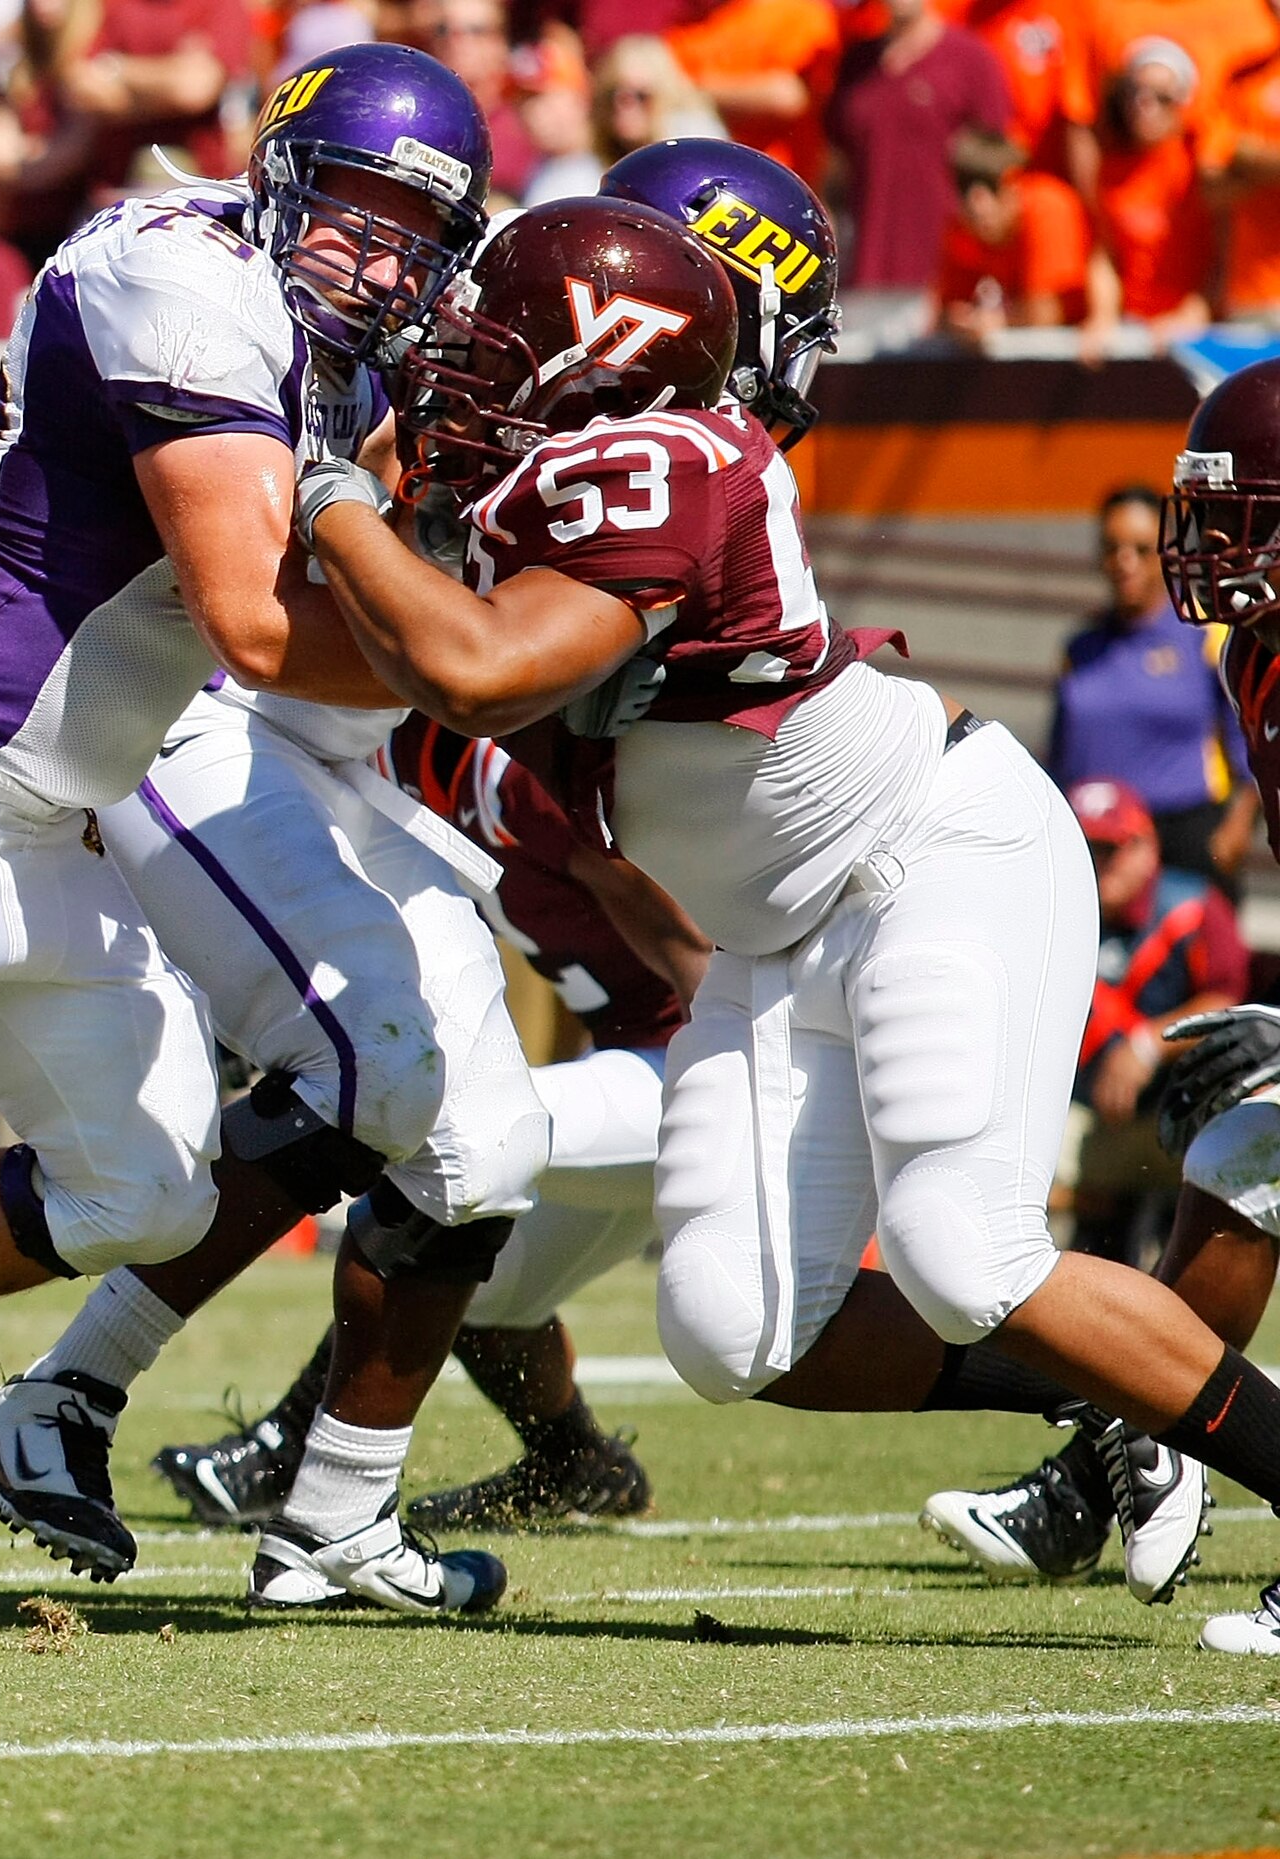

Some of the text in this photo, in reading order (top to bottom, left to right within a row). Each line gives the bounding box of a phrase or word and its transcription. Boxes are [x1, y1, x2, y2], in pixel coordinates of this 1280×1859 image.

[252, 67, 335, 133] CU
[687, 190, 821, 294] ECU
[563, 275, 693, 371] VT
[535, 438, 671, 544] 53
